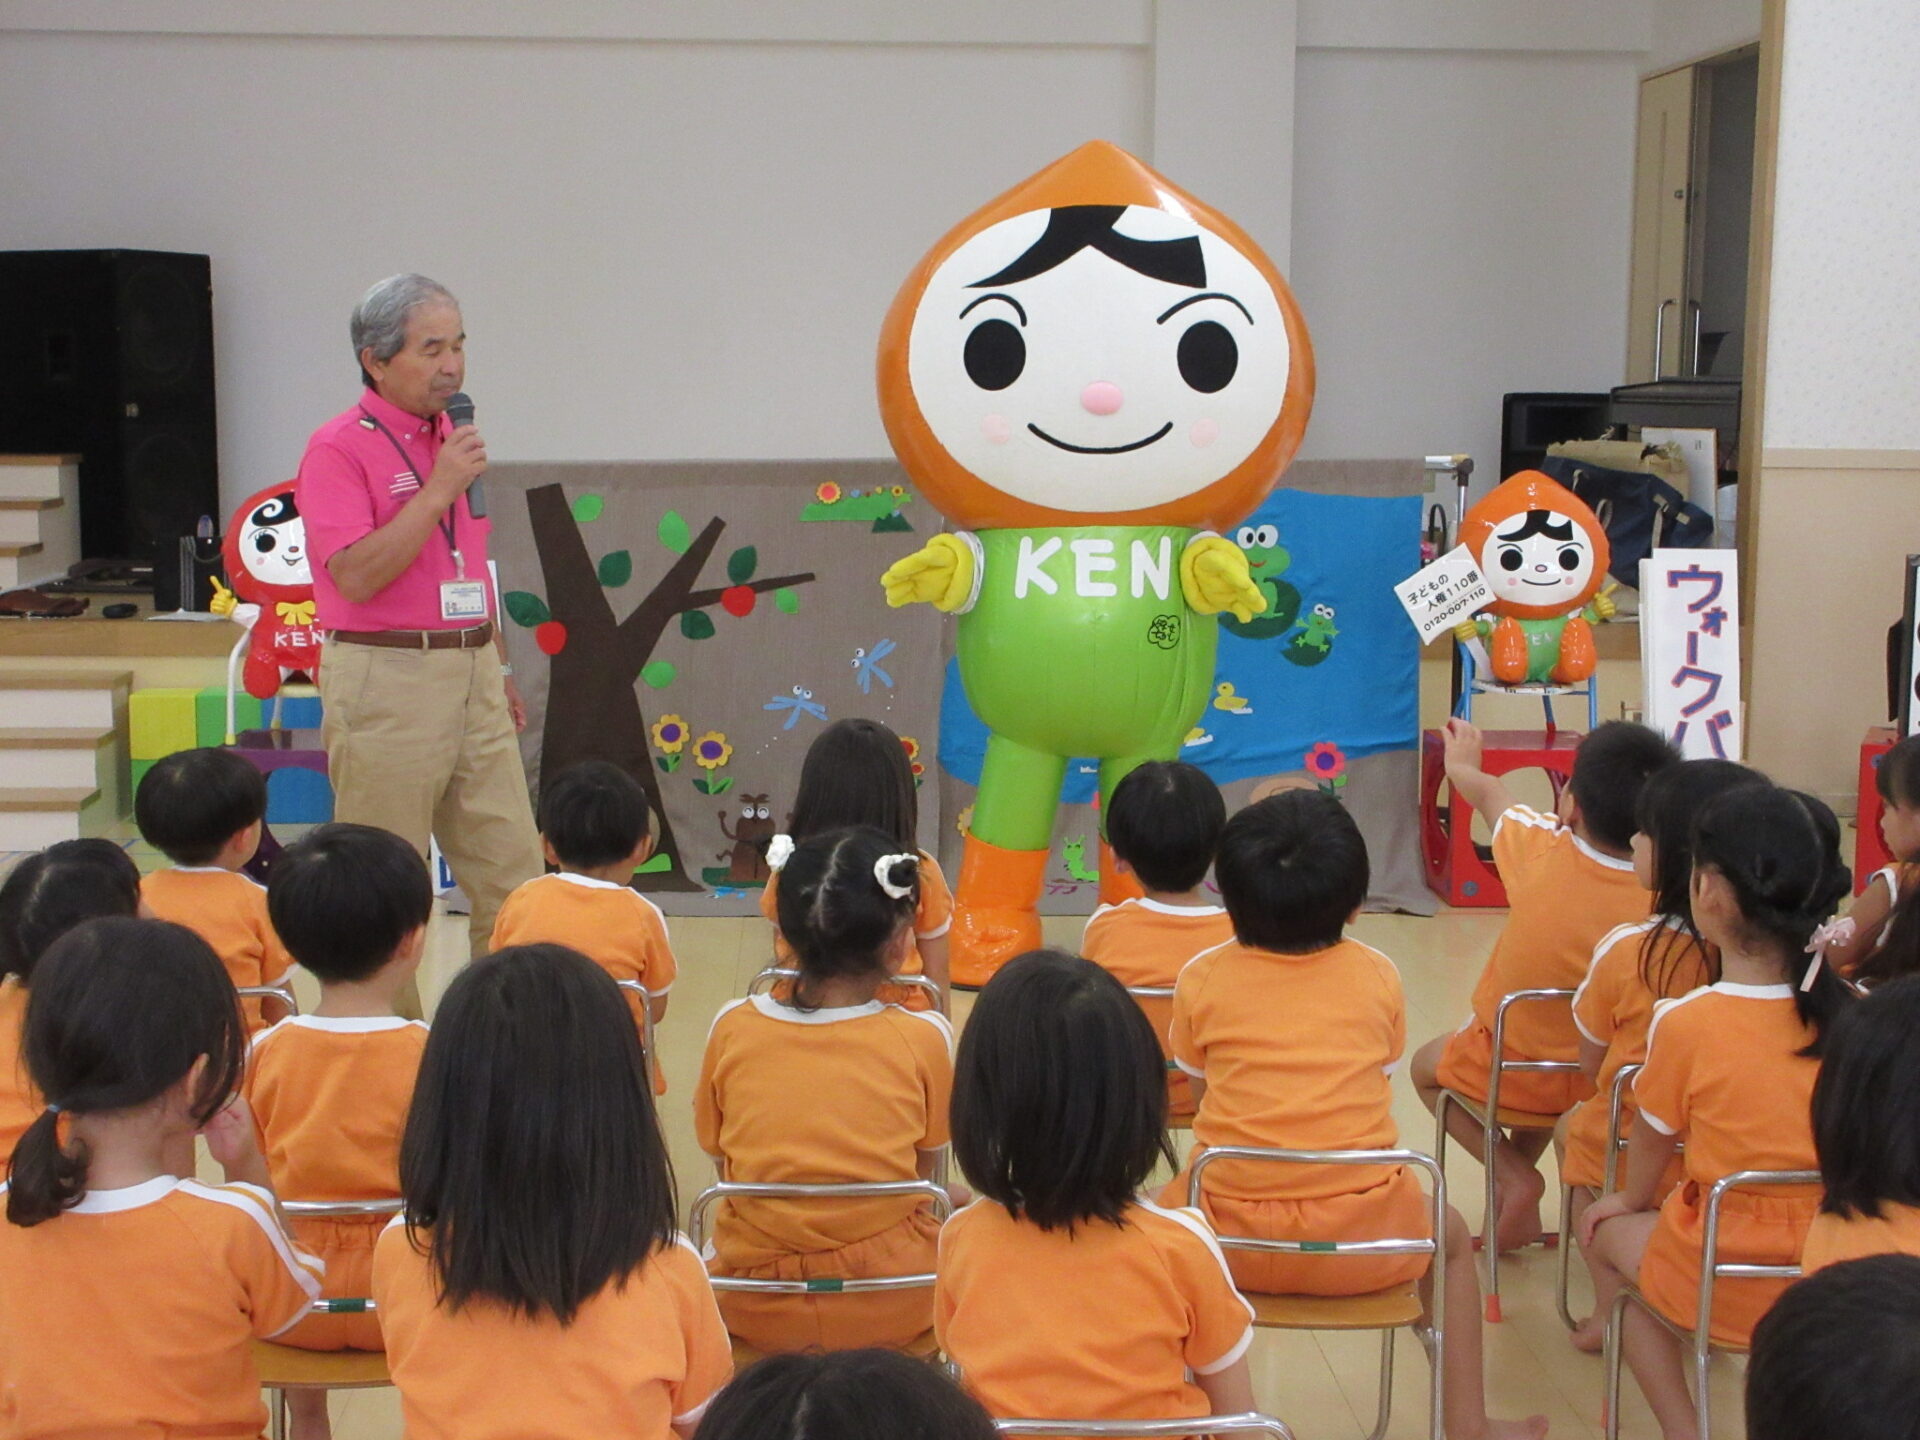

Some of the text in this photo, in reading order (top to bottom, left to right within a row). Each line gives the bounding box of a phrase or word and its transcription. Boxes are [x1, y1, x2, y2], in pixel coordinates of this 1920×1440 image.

[1014, 535, 1172, 601] KEN
[1407, 573, 1449, 605] 子どもの
[274, 630, 326, 648] KEN
